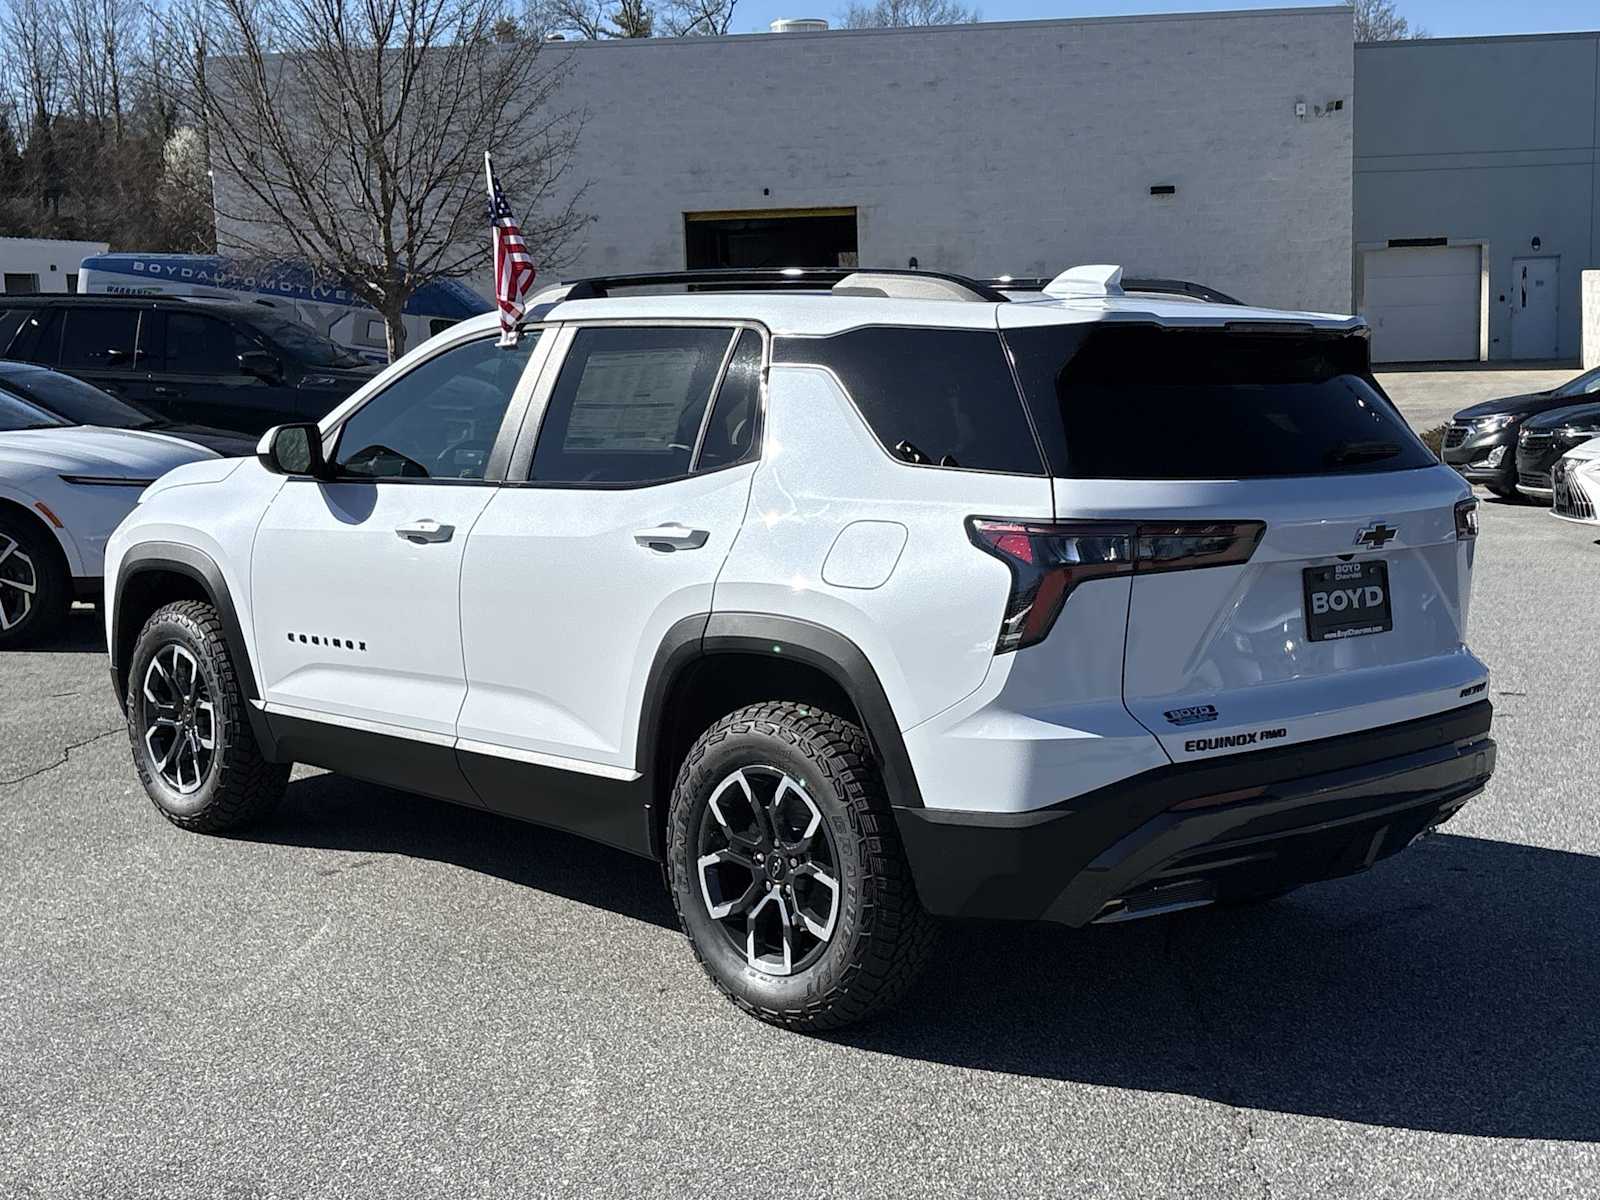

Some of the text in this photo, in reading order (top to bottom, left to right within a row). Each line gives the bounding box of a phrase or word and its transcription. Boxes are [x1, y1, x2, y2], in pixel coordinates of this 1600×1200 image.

[1335, 562, 1361, 573] BOYD
[1311, 585, 1384, 615] BOYD
[287, 632, 367, 652] EQUINOX
[1169, 706, 1211, 720] BOYD
[1184, 731, 1258, 752] EQUINOX
[1259, 728, 1287, 741] AWD
